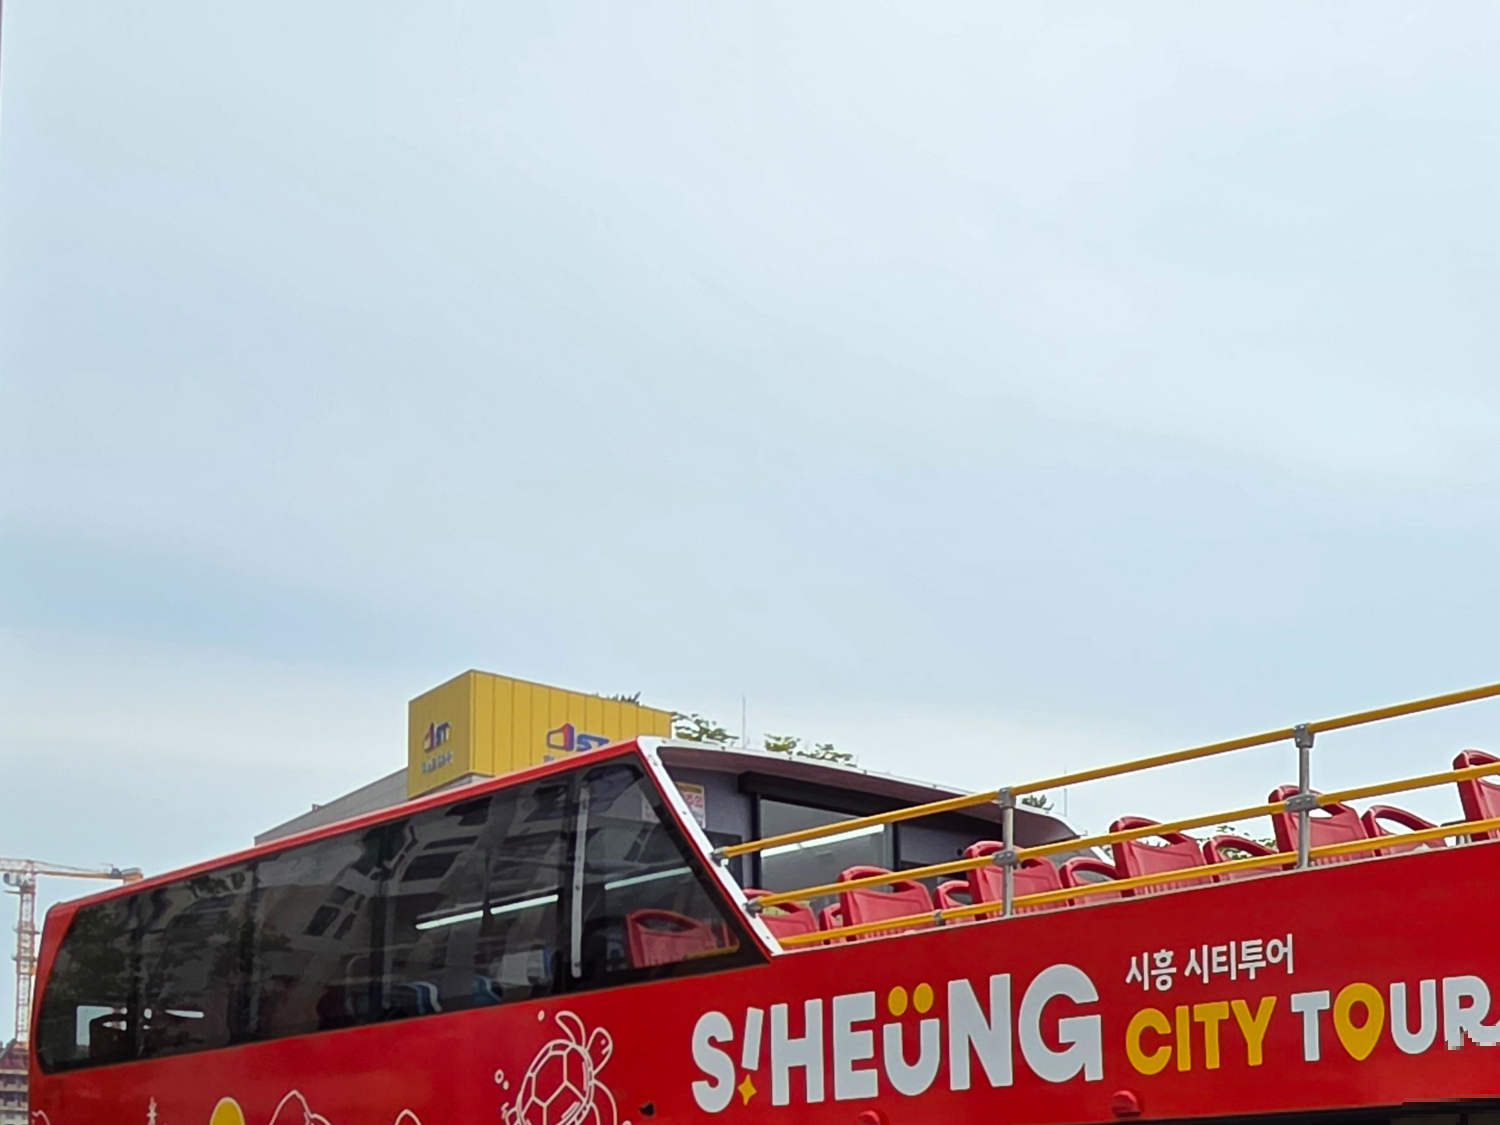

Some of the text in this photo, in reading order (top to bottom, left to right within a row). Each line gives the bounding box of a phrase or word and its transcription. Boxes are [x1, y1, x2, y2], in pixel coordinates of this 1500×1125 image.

[1125, 933, 1294, 992] 시흥 시티투어
[1125, 996, 1277, 1076] CITY
